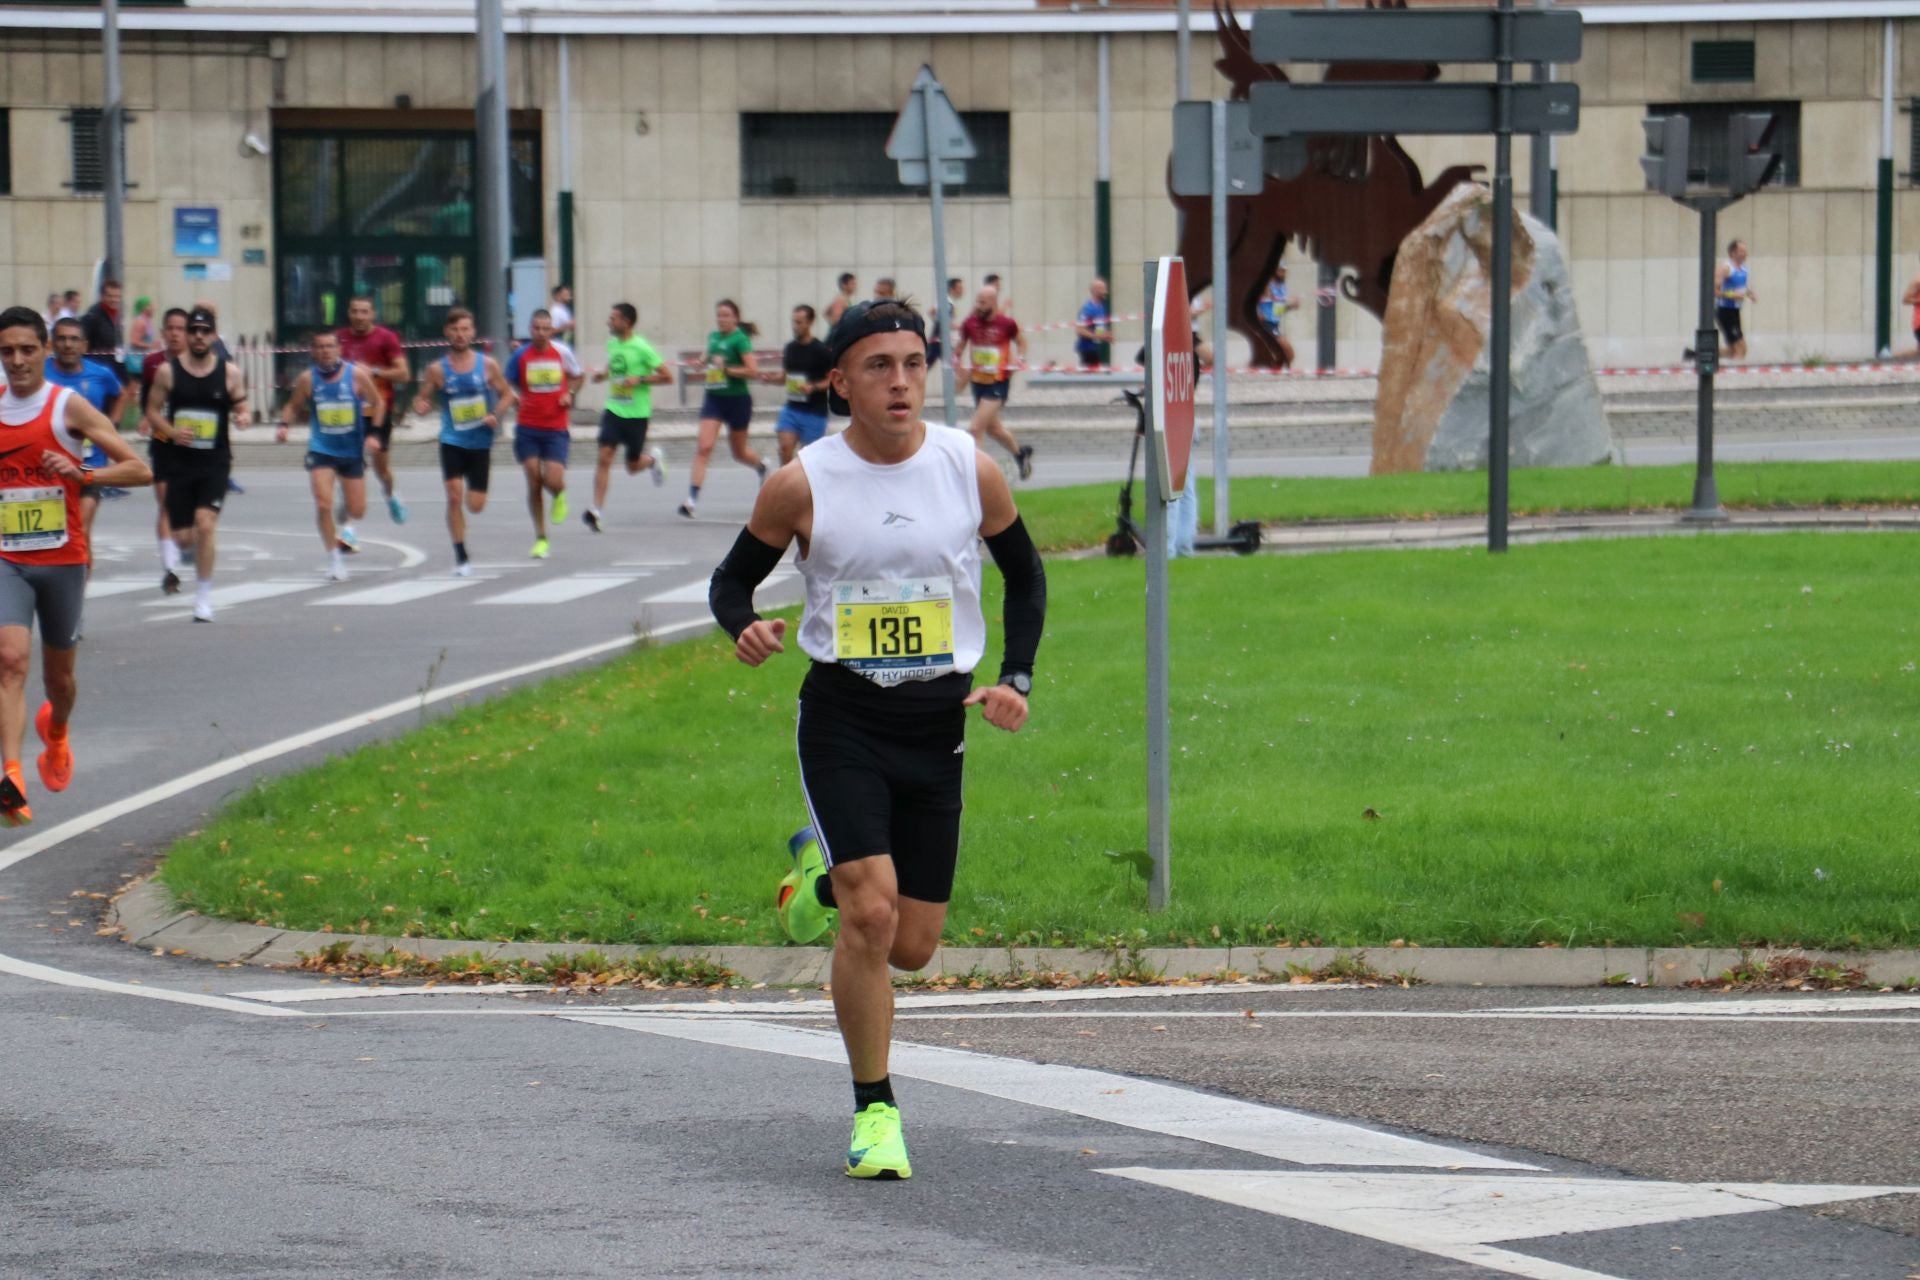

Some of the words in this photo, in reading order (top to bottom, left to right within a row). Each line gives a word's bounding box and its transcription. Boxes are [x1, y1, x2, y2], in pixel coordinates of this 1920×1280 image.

[1167, 352, 1191, 403] STOP
[0, 467, 19, 482] OP
[18, 508, 44, 532] 112
[881, 606, 910, 615] DAVID
[868, 616, 923, 656] 136
[882, 668, 936, 680] HYUNDAI
